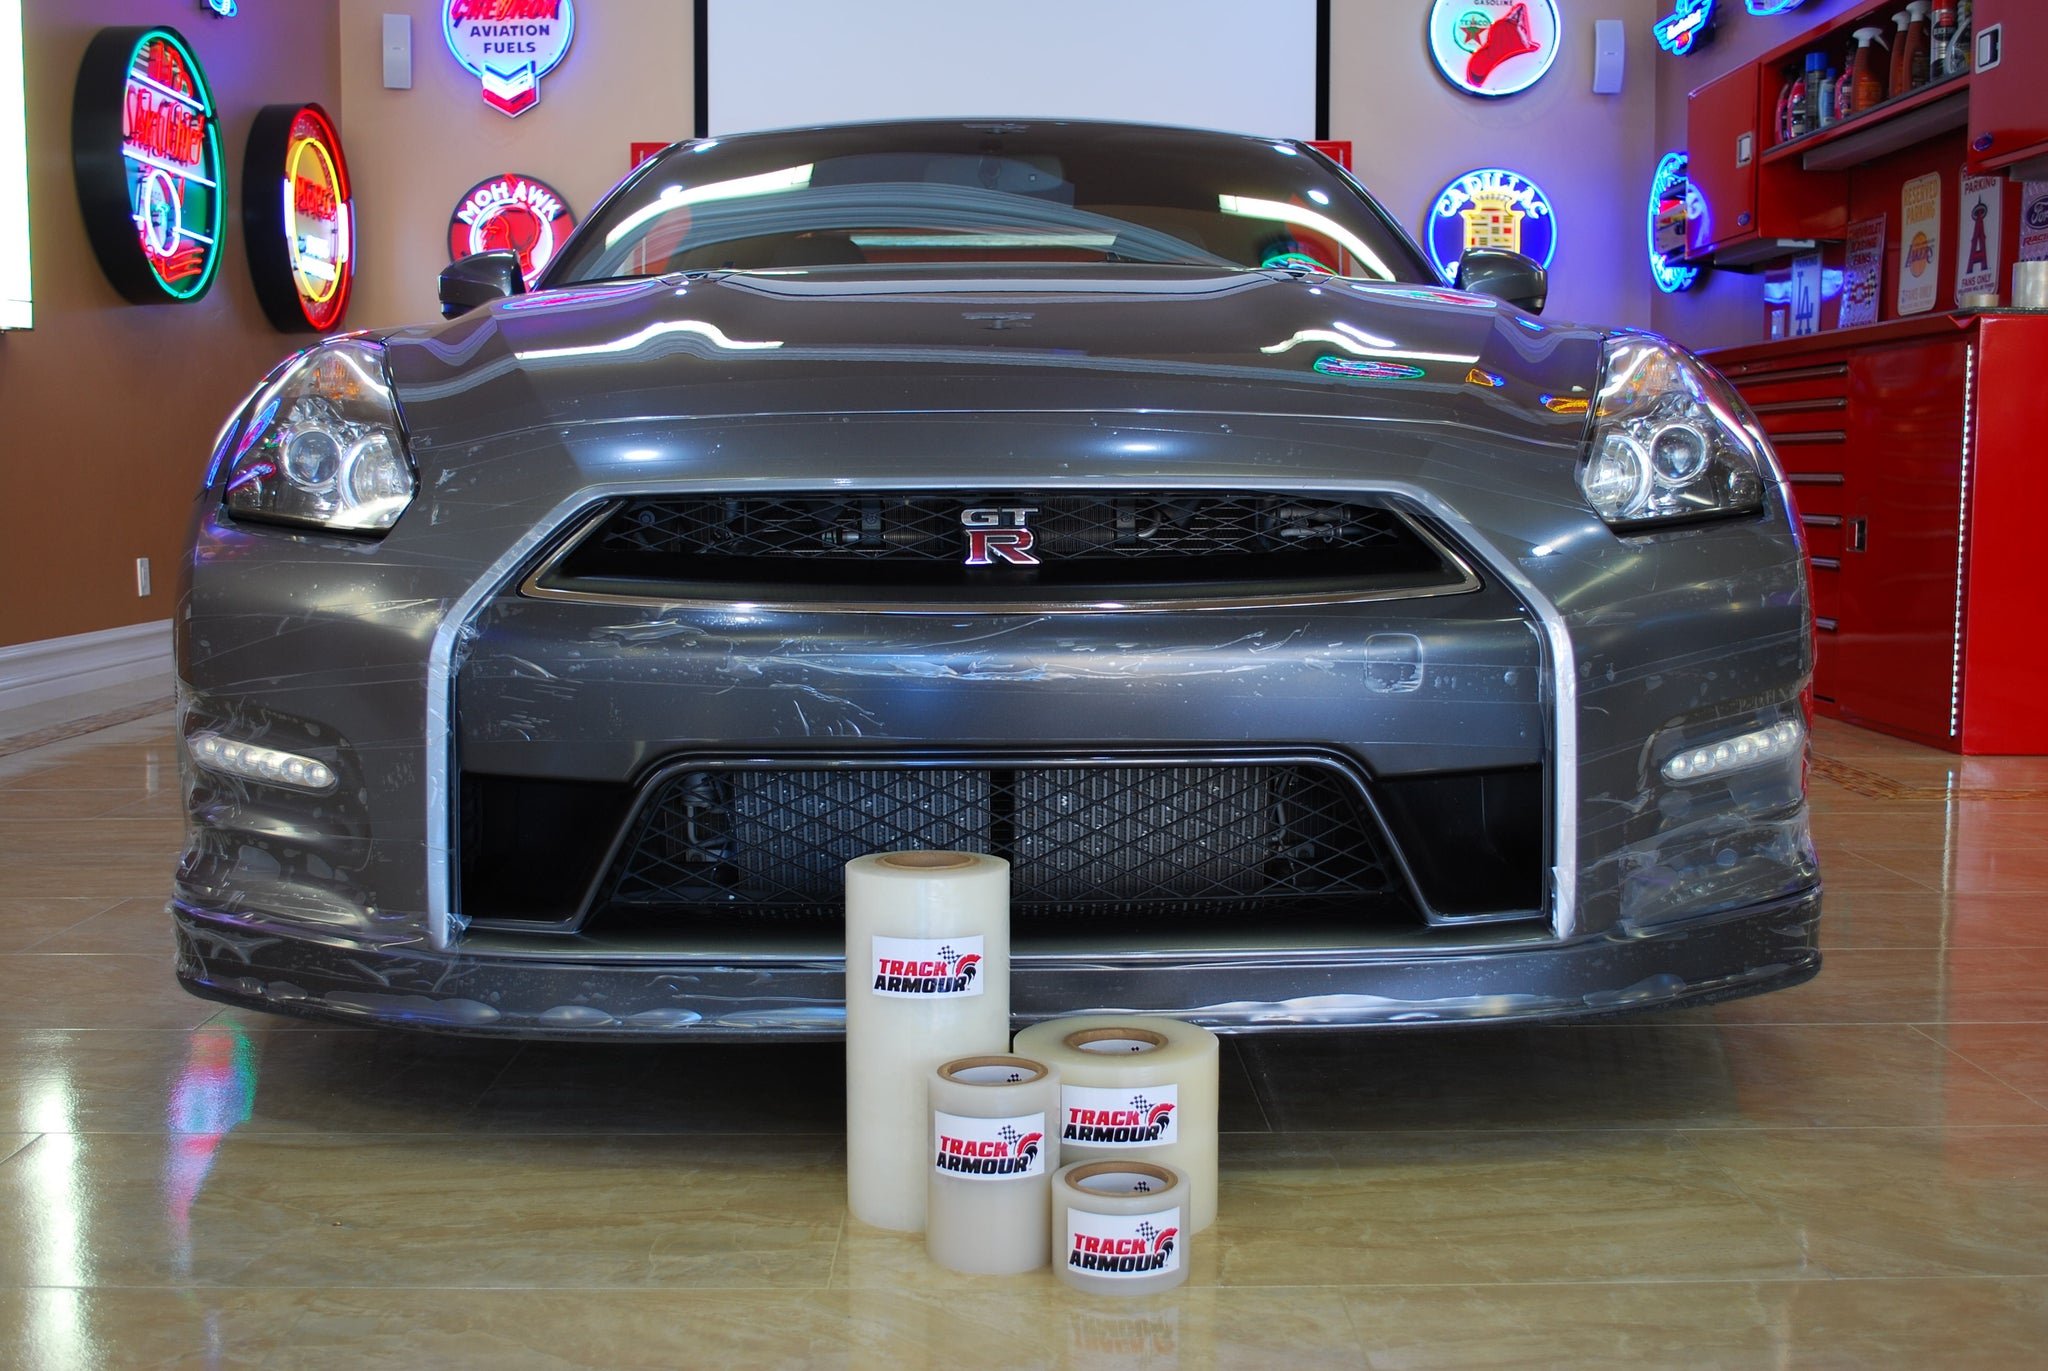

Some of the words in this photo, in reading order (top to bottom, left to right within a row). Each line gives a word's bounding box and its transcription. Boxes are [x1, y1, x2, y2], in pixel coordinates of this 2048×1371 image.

[470, 24, 551, 38] AVIATION
[1460, 19, 1490, 27] TEXACO
[483, 41, 537, 54] FUELS
[1438, 171, 1549, 219] CADILLAC
[1964, 177, 1997, 196] PARKING
[457, 181, 562, 226] MOHAWK
[879, 958, 948, 977] TRACK
[874, 974, 968, 994] ARMOUR
[1069, 1107, 1140, 1126] TRACK
[1063, 1124, 1161, 1143] ARMOUR
[940, 1135, 1009, 1158] TRACK
[936, 1152, 1030, 1175] ARMOUR
[1074, 1233, 1146, 1255] TRACK
[1069, 1250, 1166, 1273] ARMOUR
